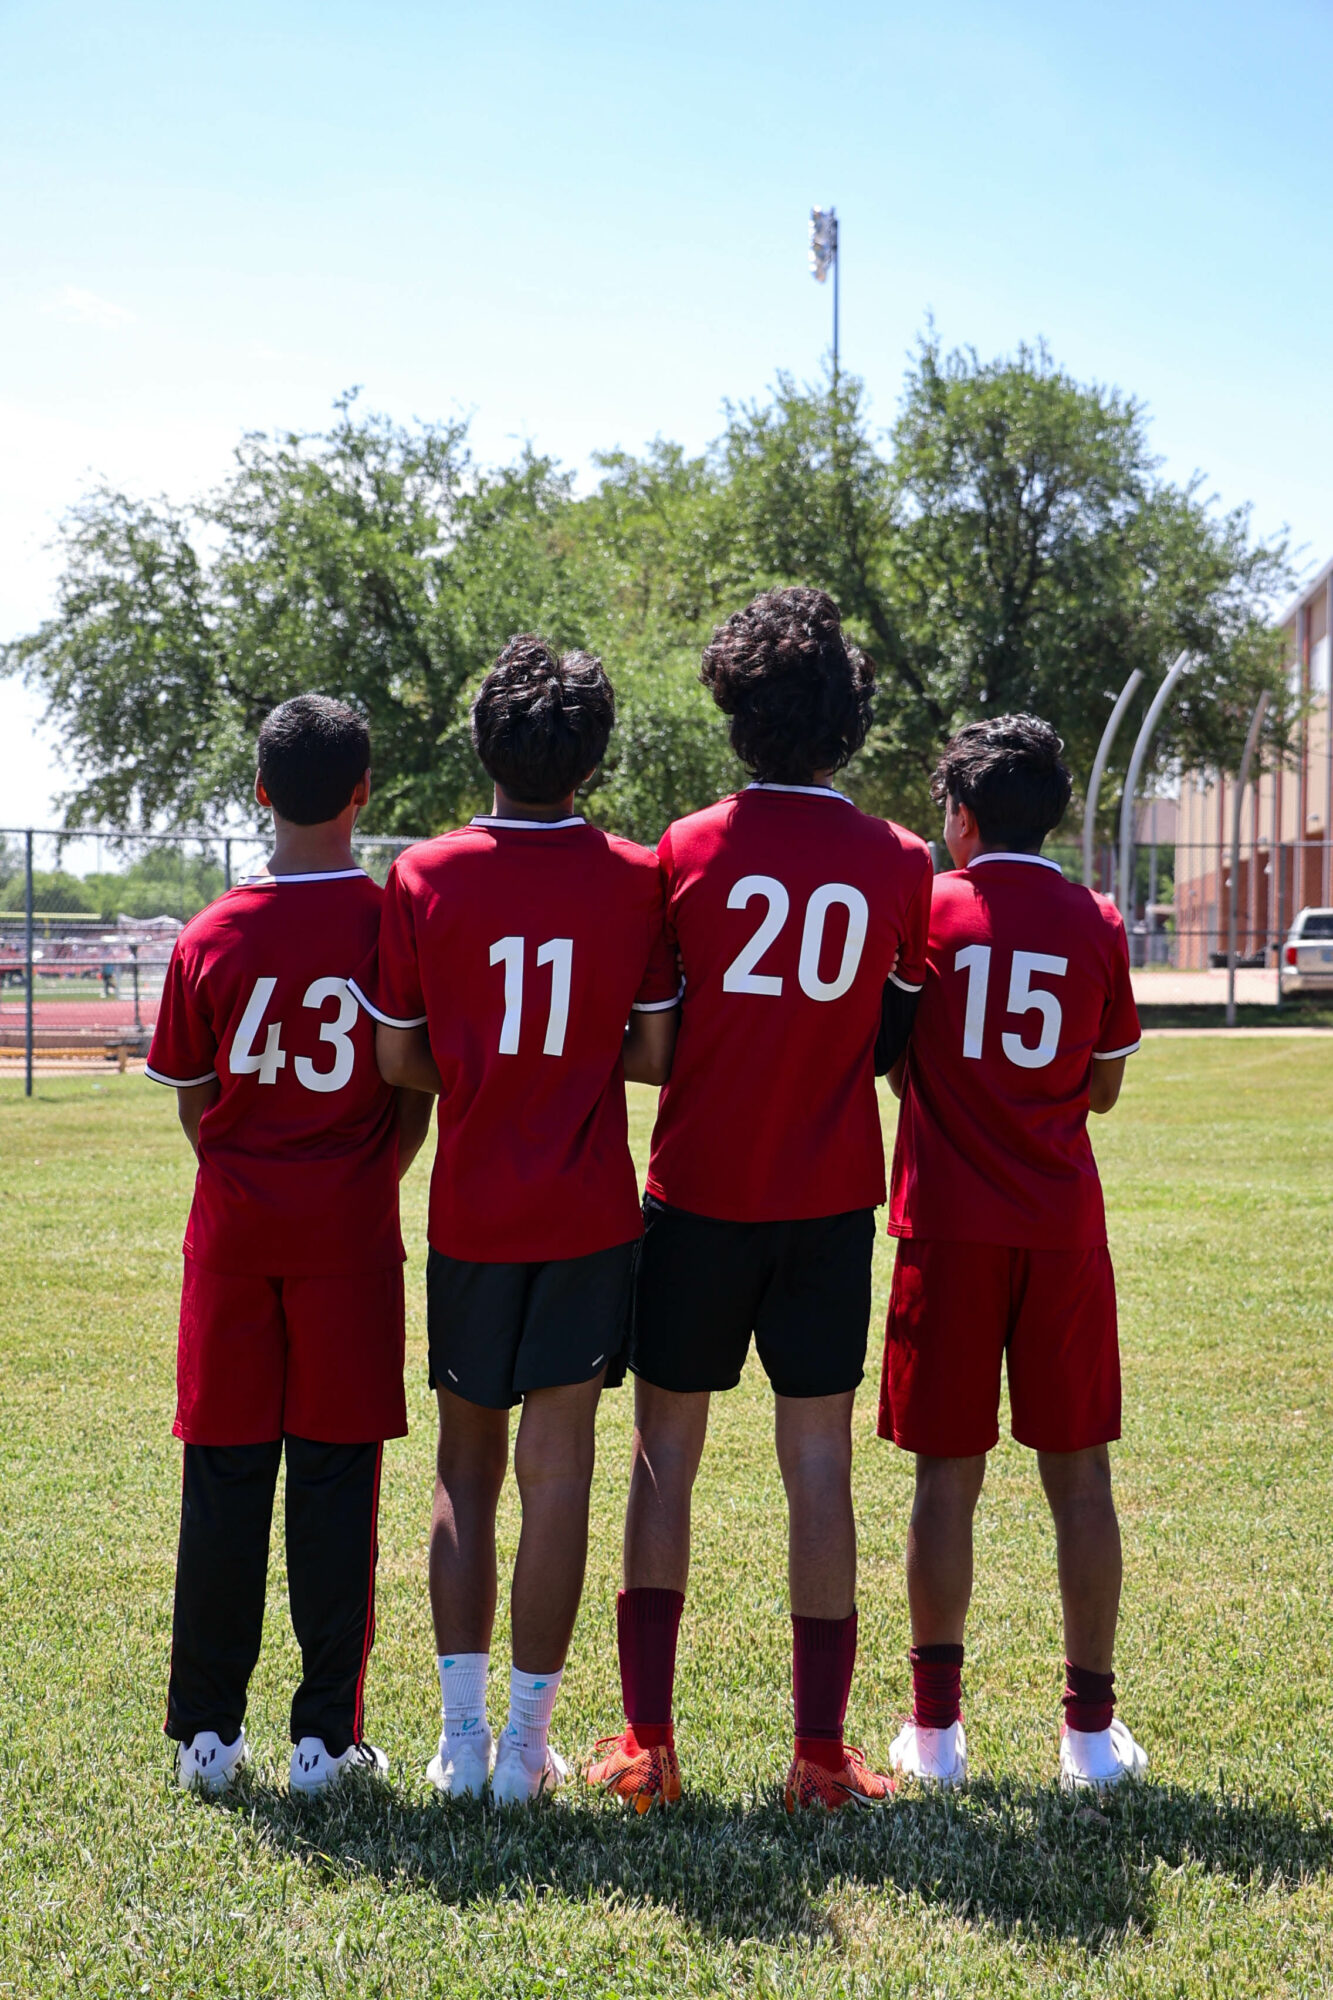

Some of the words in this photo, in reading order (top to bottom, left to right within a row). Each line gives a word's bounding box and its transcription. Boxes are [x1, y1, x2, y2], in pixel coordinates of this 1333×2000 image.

[489, 936, 574, 1057] 11
[723, 875, 868, 1001] 20
[229, 976, 359, 1093] 43
[954, 944, 1068, 1069] 15
